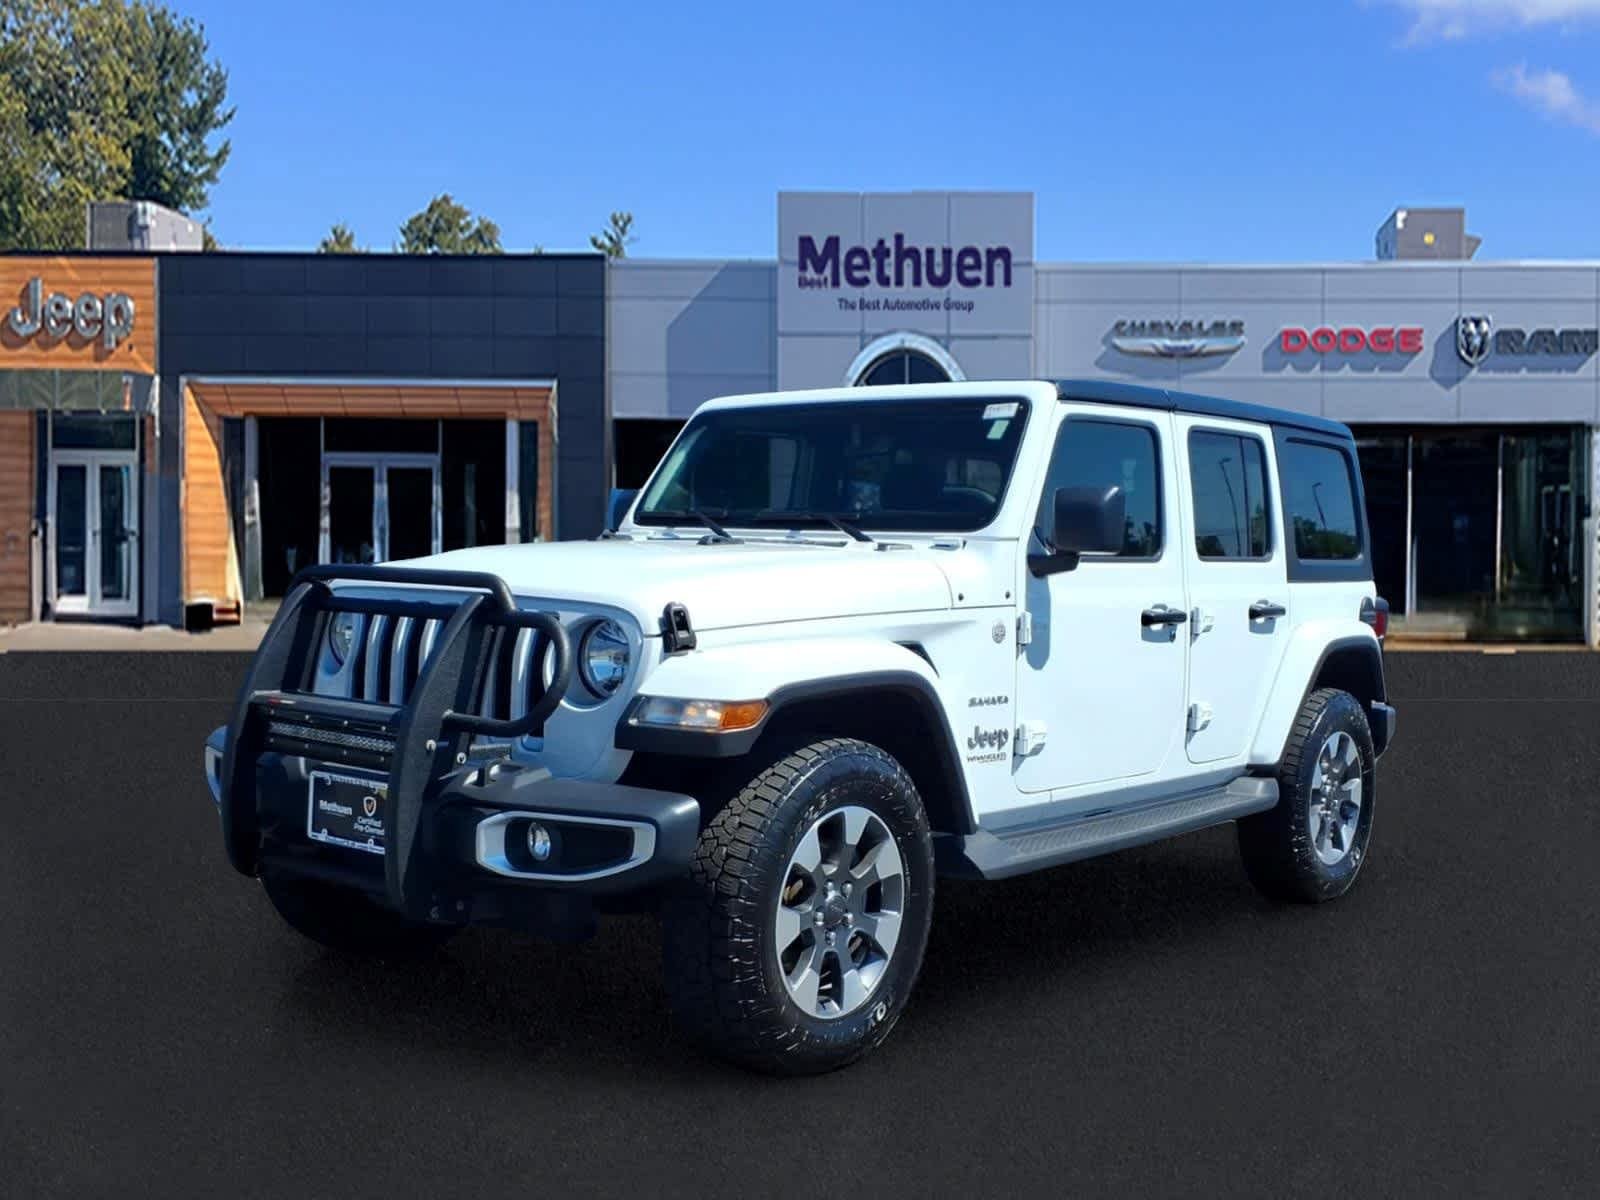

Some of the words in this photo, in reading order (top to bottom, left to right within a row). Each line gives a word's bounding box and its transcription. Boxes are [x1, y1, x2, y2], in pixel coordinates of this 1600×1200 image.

[798, 233, 1013, 288] Methuen
[9, 276, 135, 349] Jeep
[838, 298, 857, 311] The
[859, 298, 880, 311] Best
[883, 298, 941, 311] Automotive
[943, 297, 975, 313] Group
[1113, 319, 1246, 336] CHRYSLER
[1281, 327, 1425, 354] DODGE
[1498, 328, 1600, 354] RAM
[968, 695, 1009, 708] SAHARA
[967, 725, 1009, 752] Jeep
